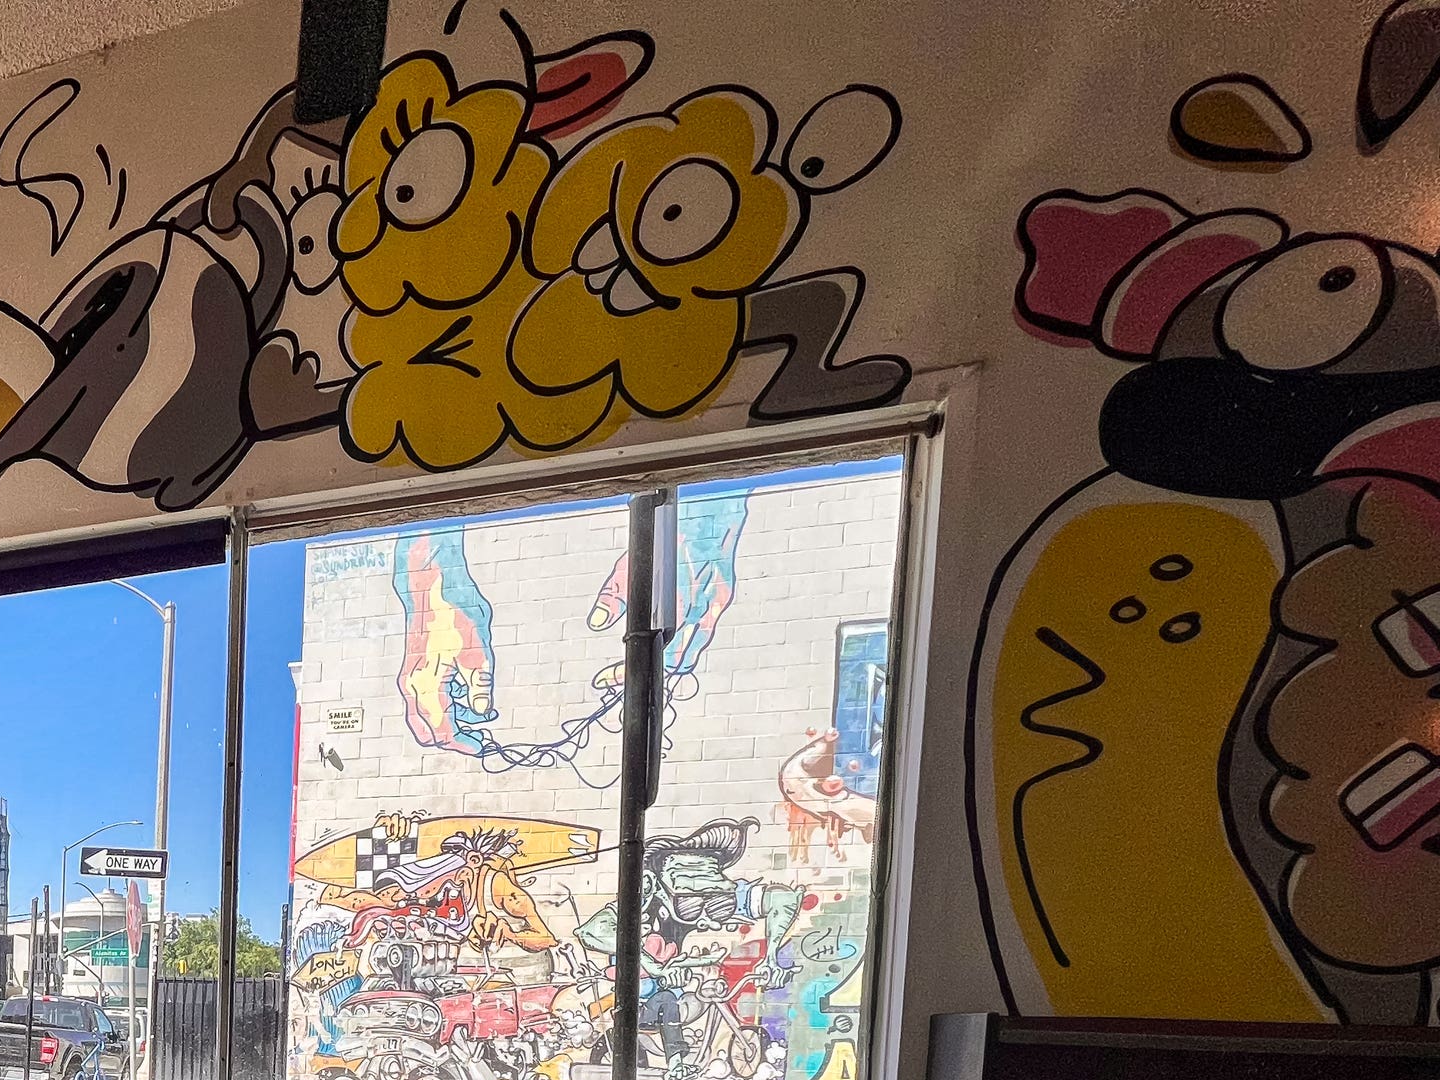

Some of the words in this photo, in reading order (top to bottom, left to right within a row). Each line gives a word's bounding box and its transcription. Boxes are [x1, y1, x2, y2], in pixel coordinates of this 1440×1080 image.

[106, 857, 129, 869] ONE
[134, 858, 158, 870] WAY
[309, 957, 347, 975] LONG
